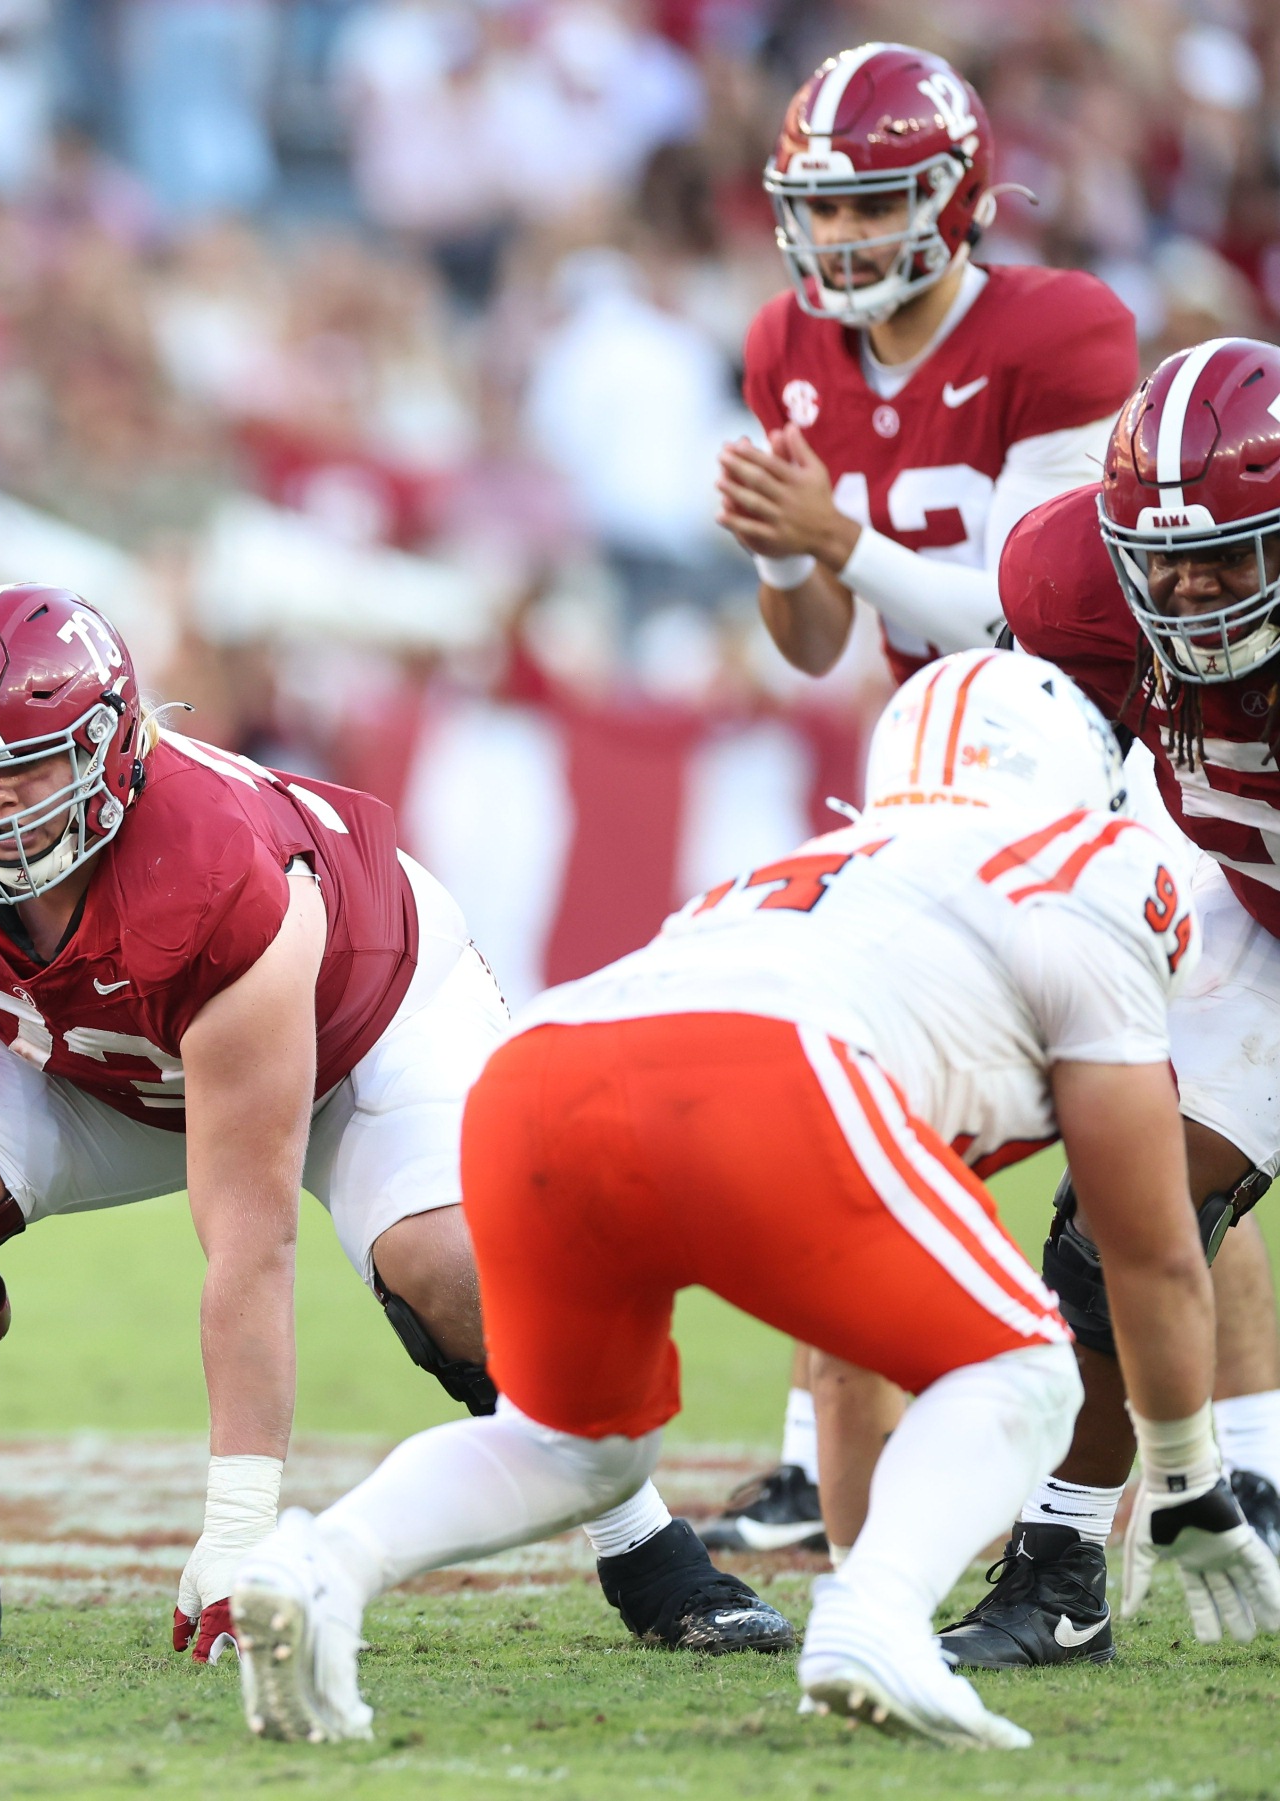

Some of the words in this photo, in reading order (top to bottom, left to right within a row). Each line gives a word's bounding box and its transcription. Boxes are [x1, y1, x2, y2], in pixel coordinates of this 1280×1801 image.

[917, 74, 978, 140] 12
[1153, 515, 1191, 528] BAMA
[57, 611, 122, 685] 73
[962, 745, 990, 771] 94
